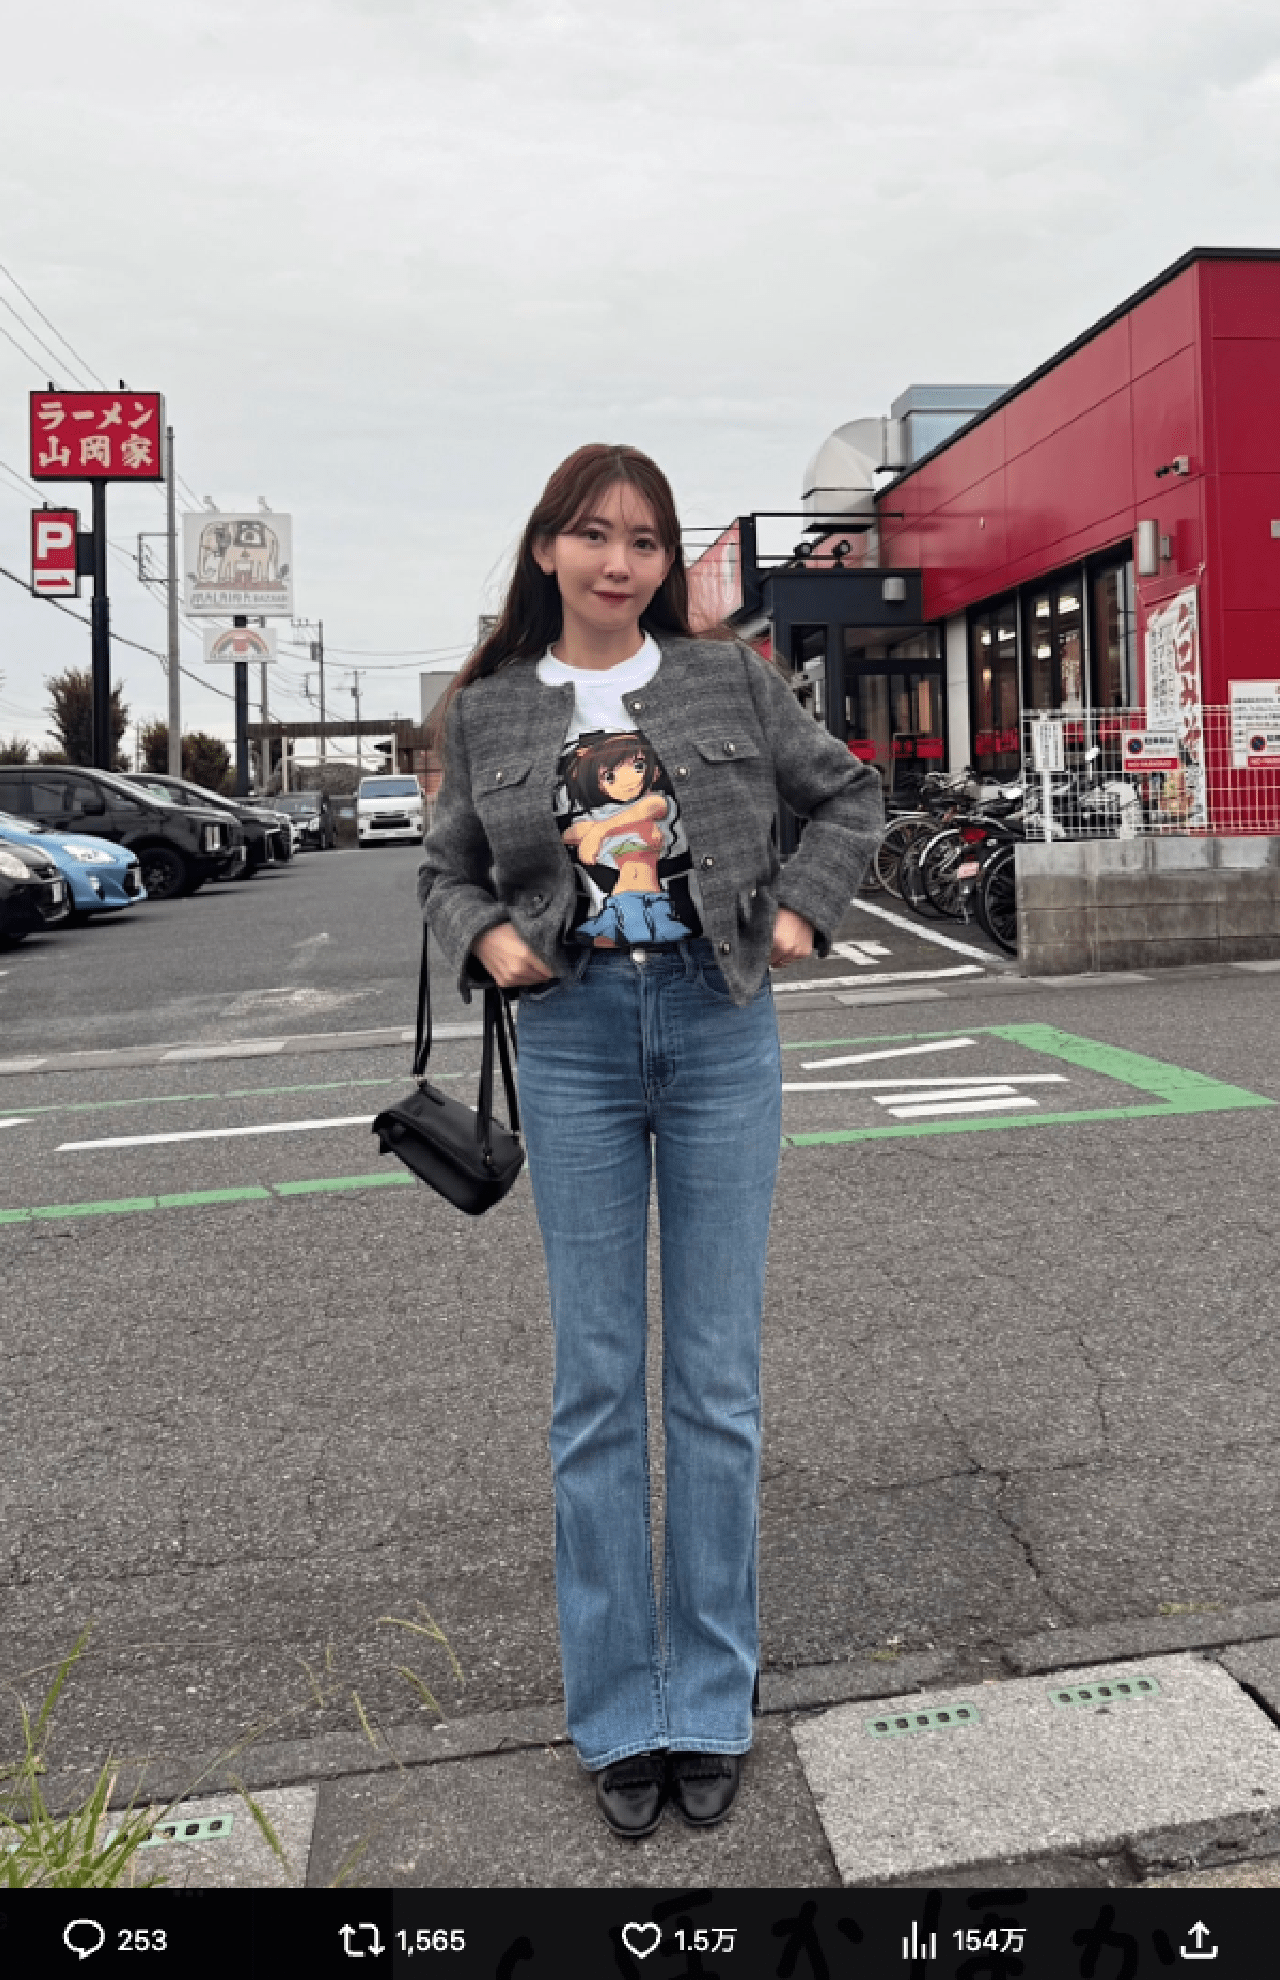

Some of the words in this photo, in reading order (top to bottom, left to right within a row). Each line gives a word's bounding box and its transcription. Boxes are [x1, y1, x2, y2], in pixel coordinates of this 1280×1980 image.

[37, 402, 153, 429] ラーメン
[38, 434, 153, 468] 山岡家
[37, 521, 74, 560] P
